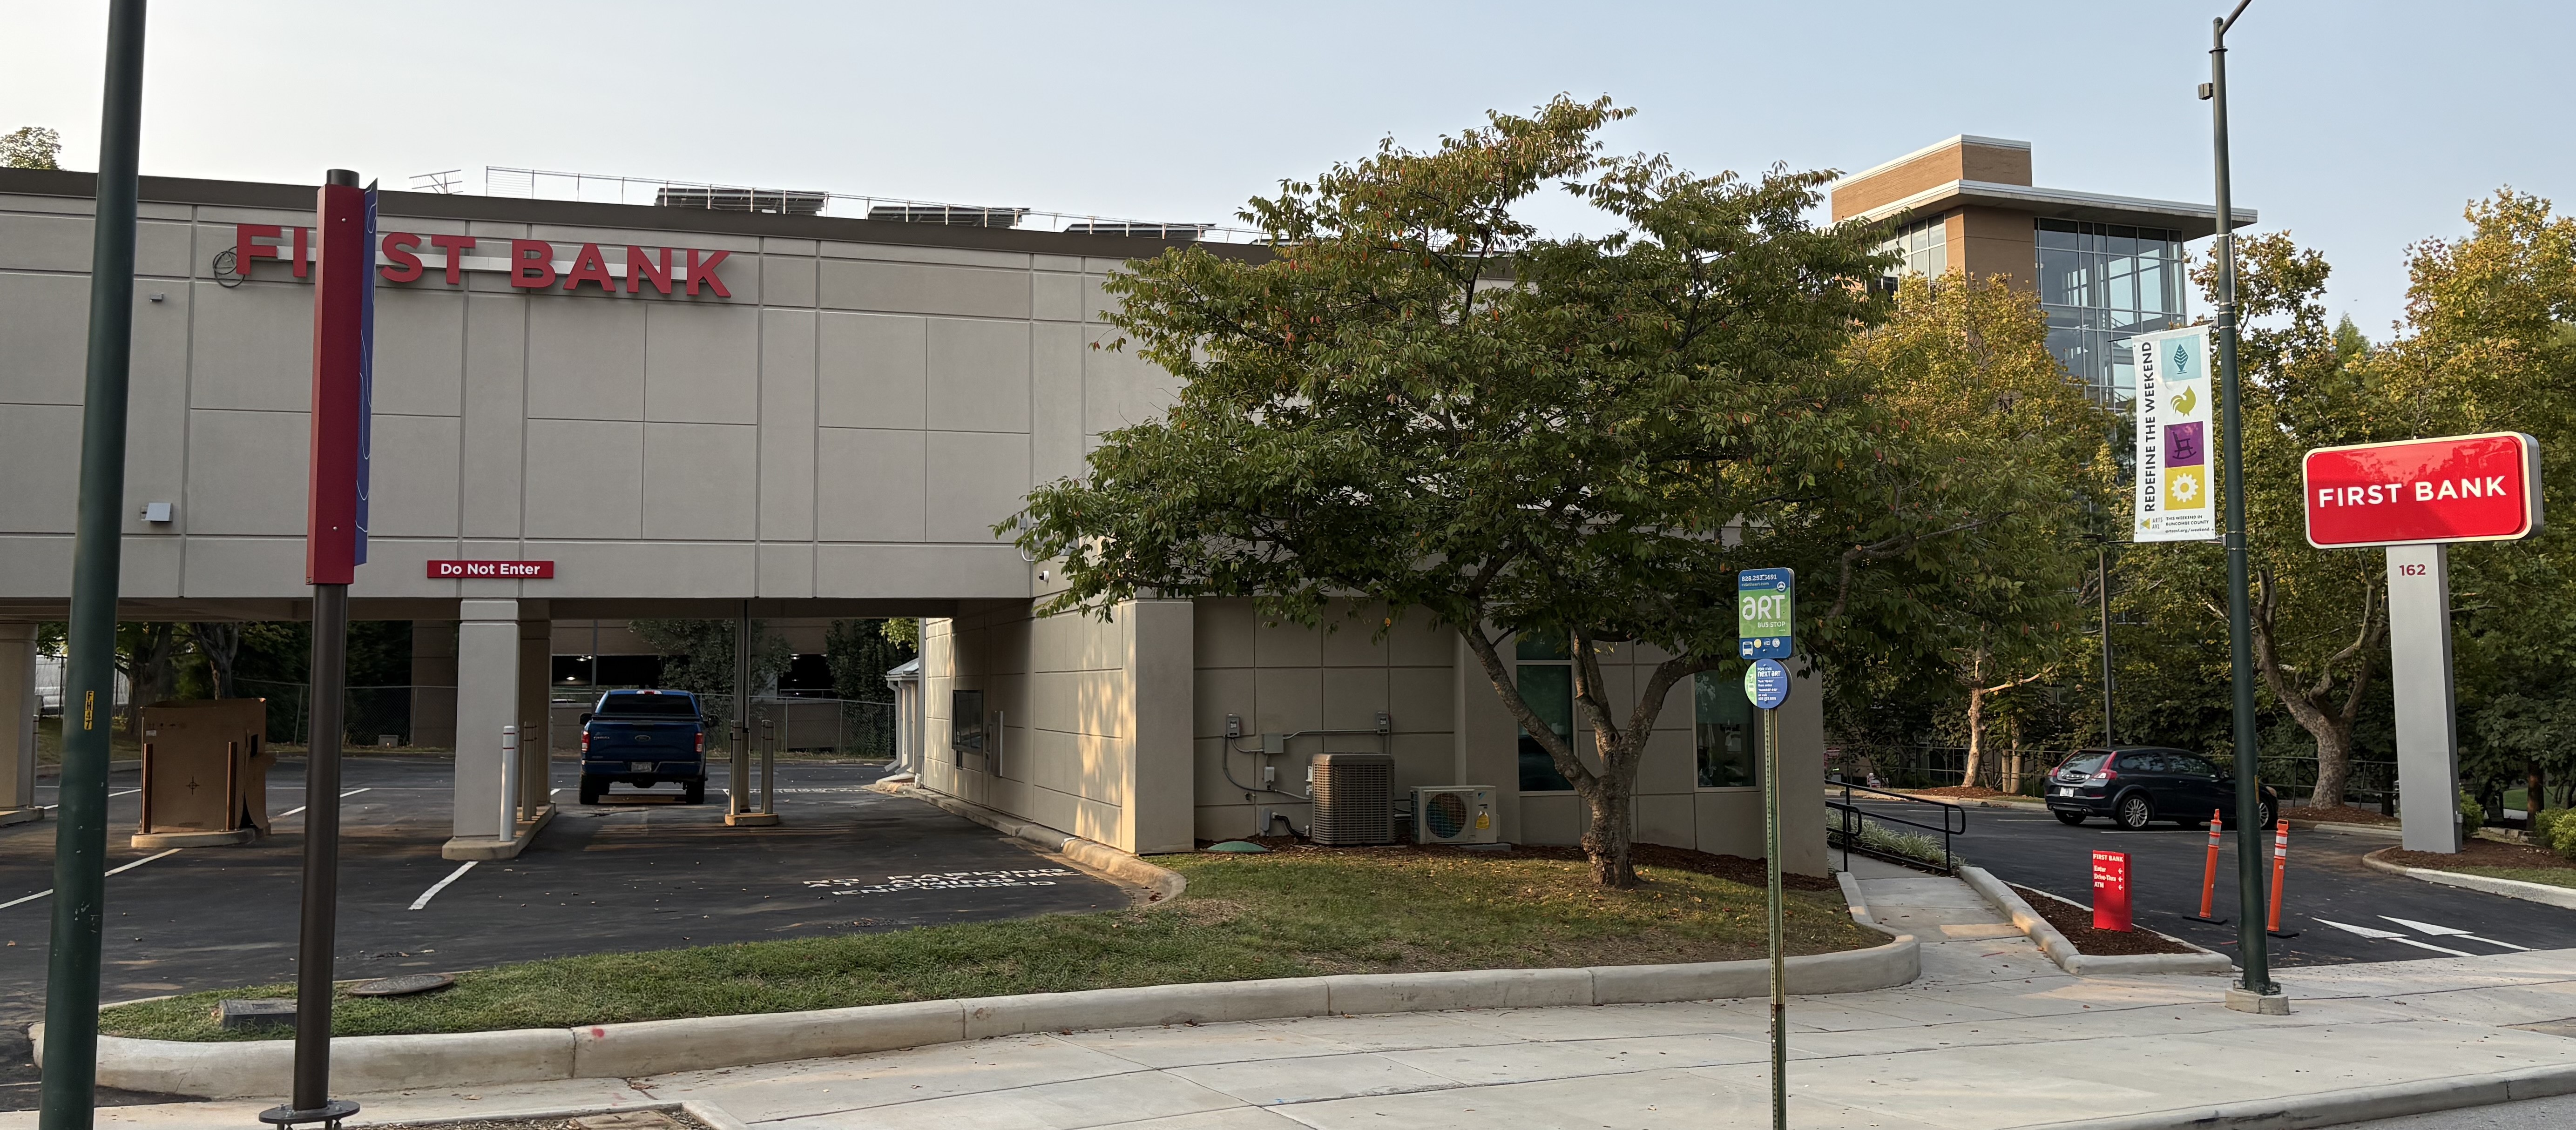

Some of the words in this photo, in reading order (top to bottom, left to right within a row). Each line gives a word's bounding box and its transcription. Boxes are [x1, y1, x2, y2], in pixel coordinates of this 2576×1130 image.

[237, 224, 476, 284] FIST
[511, 239, 731, 298] BANK
[2142, 342, 2155, 413] WEEKEND
[2146, 417, 2156, 443] THE
[2145, 445, 2156, 511] REDEFINE
[2319, 483, 2402, 508] FIRST
[2415, 475, 2507, 501] BANK
[441, 563, 462, 575] Do
[467, 563, 495, 575] Not
[500, 564, 541, 575] Enter
[2399, 563, 2426, 576] 162
[887, 868, 1066, 880] PARKING
[2094, 873, 2116, 881] Drive-Thru
[832, 881, 1057, 895] ENFORCED
